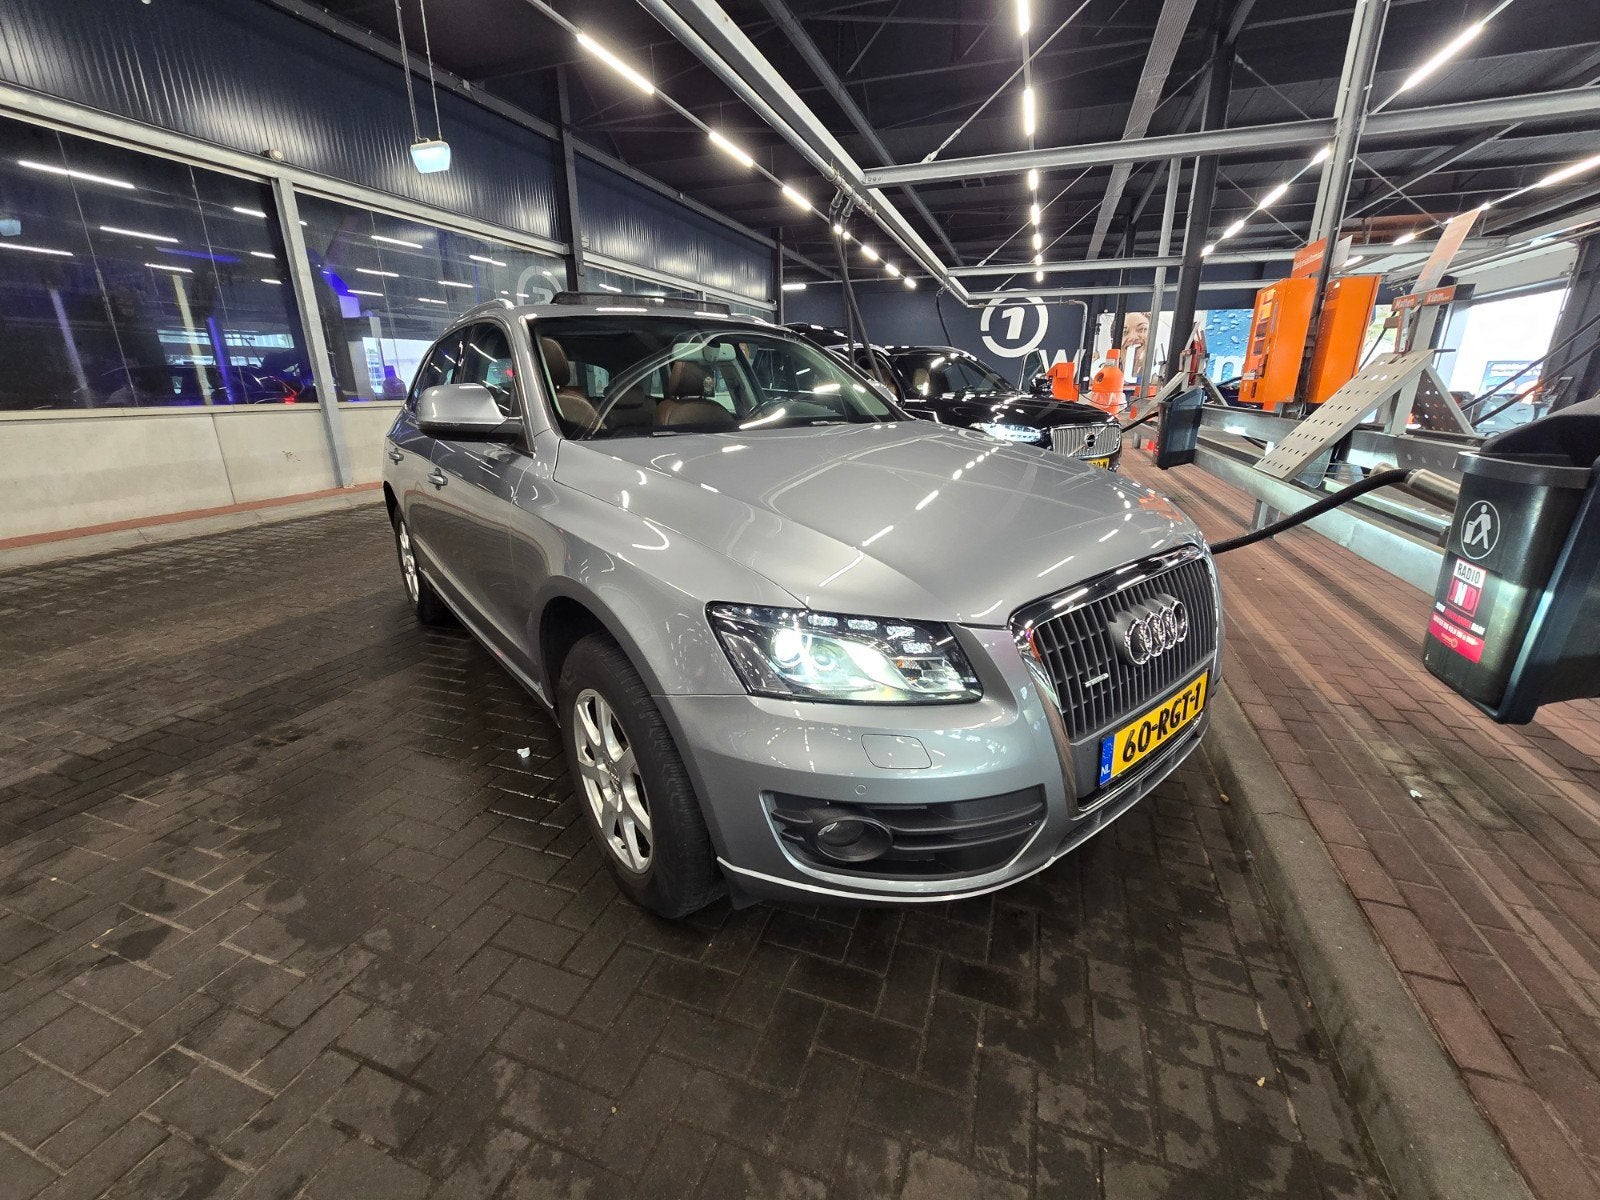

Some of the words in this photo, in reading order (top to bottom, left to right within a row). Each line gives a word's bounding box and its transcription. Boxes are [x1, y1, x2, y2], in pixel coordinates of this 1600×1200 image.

[1002, 307, 1025, 340] 1
[1456, 562, 1481, 584] RADIO
[1122, 681, 1202, 763] 60-RGT-1
[1100, 763, 1110, 777] NL
